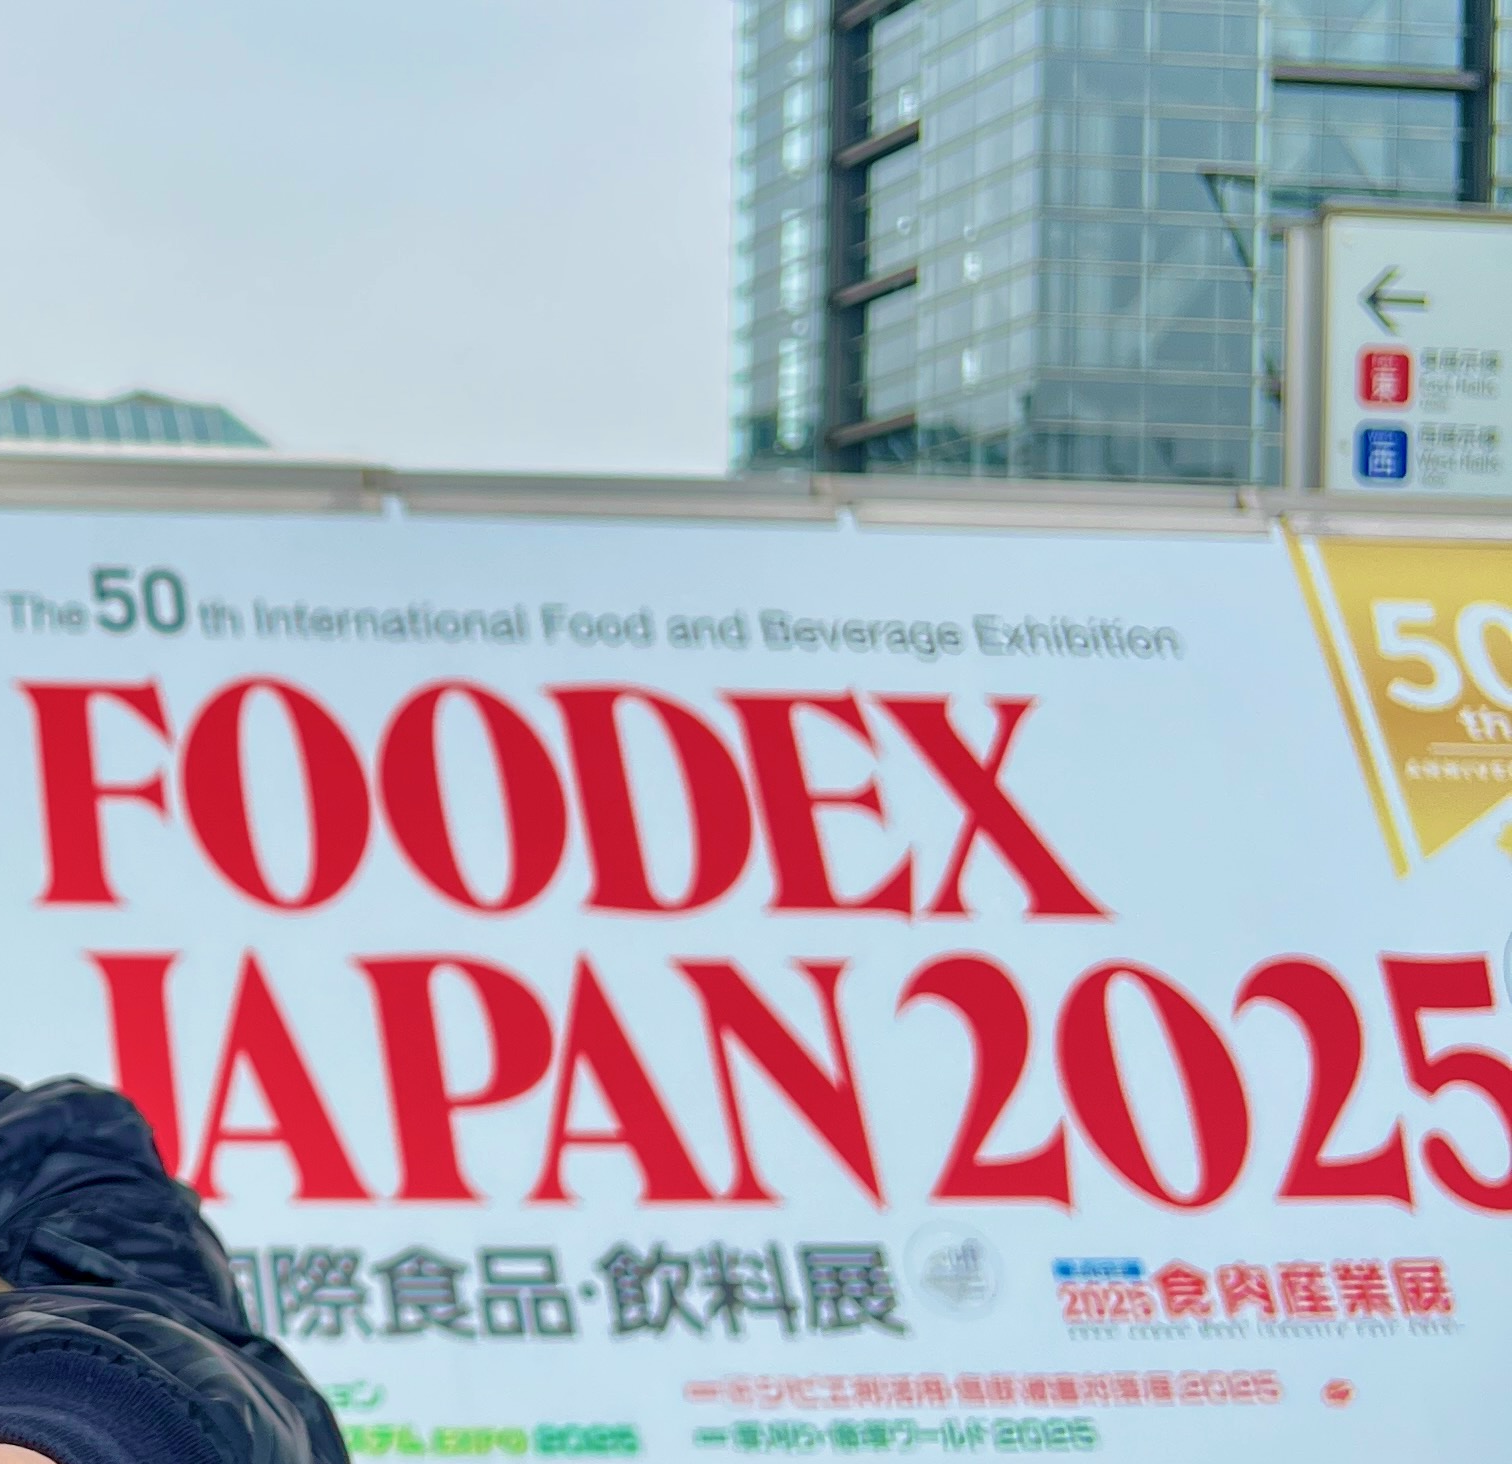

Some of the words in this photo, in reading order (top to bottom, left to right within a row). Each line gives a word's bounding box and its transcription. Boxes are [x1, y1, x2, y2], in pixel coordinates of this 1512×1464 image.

[0, 590, 85, 634] The
[91, 566, 186, 636] 50
[199, 600, 244, 641] th
[254, 597, 529, 645] International
[539, 601, 654, 650] Food
[667, 609, 745, 650] and
[760, 608, 966, 662] Beverage
[974, 613, 1184, 662] Exhibition
[16, 675, 1114, 922] FOODEX
[86, 948, 887, 1210] JAPAN
[896, 948, 1512, 1214] 2025
[1058, 1282, 1154, 1324] 2025
